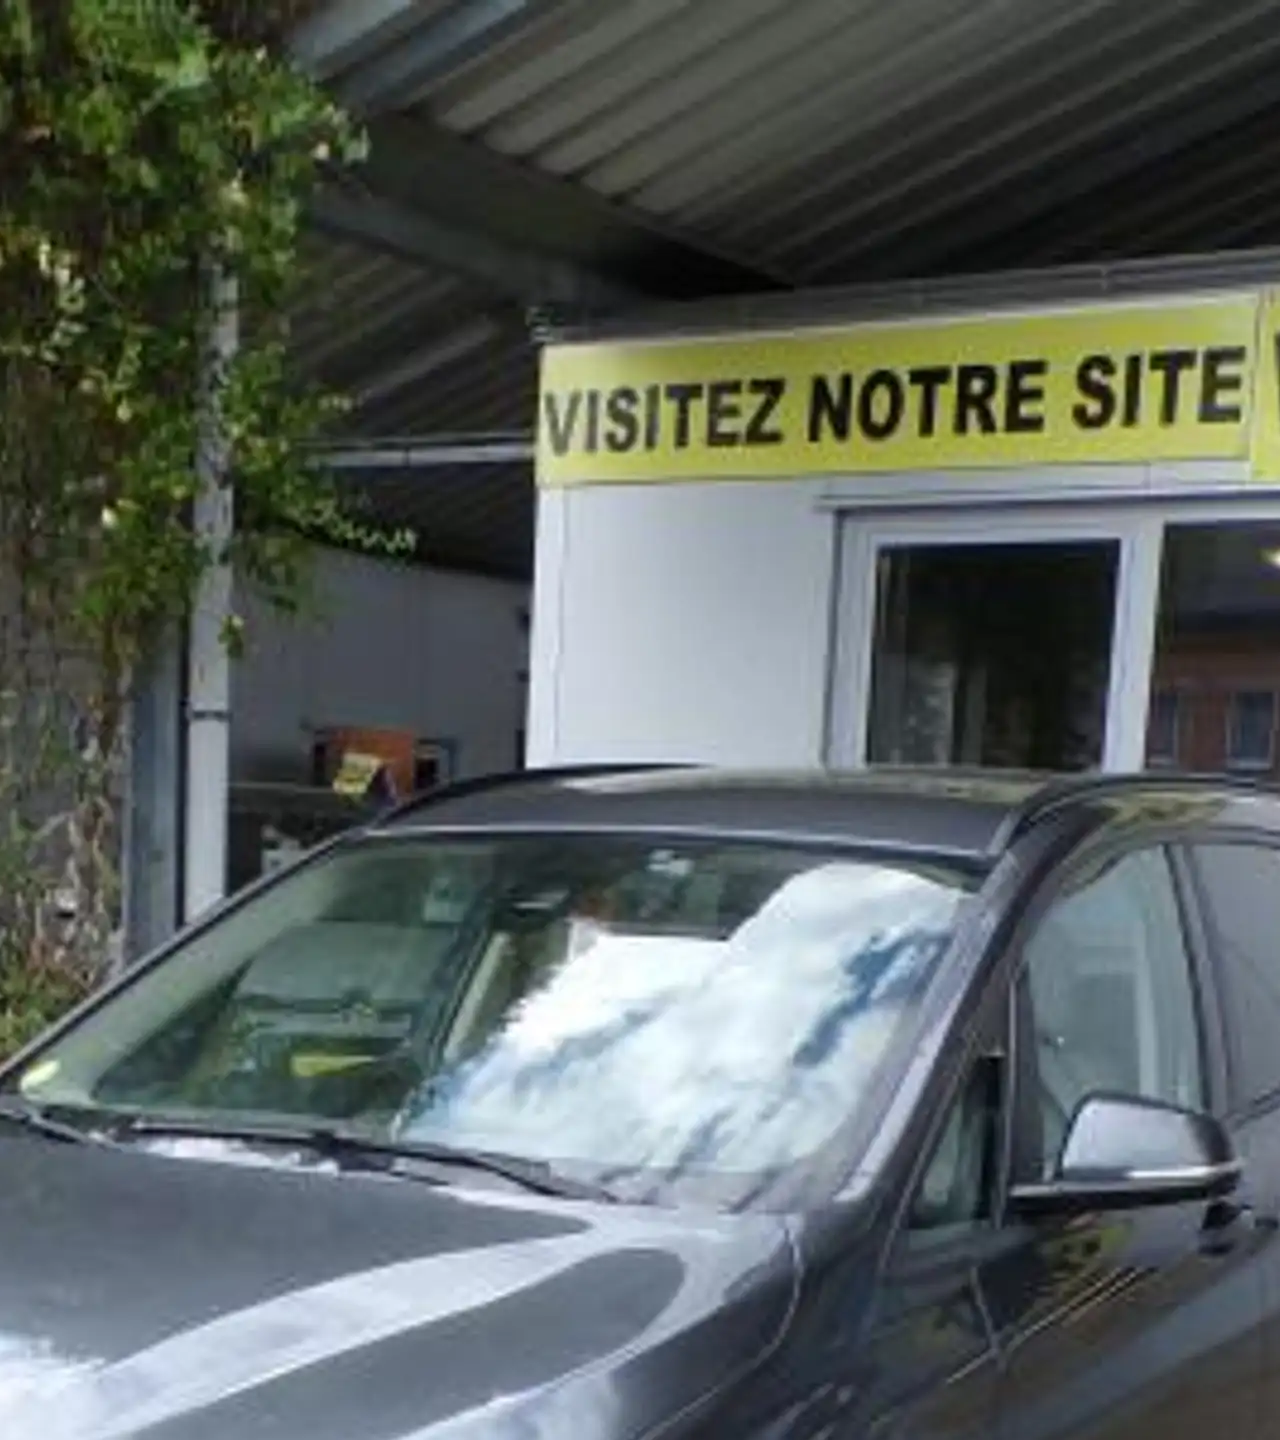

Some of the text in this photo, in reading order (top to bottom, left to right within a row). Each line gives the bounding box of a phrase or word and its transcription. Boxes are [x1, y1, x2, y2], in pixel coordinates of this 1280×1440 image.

[542, 346, 1247, 456] VISITEZ NOTRE SITE
